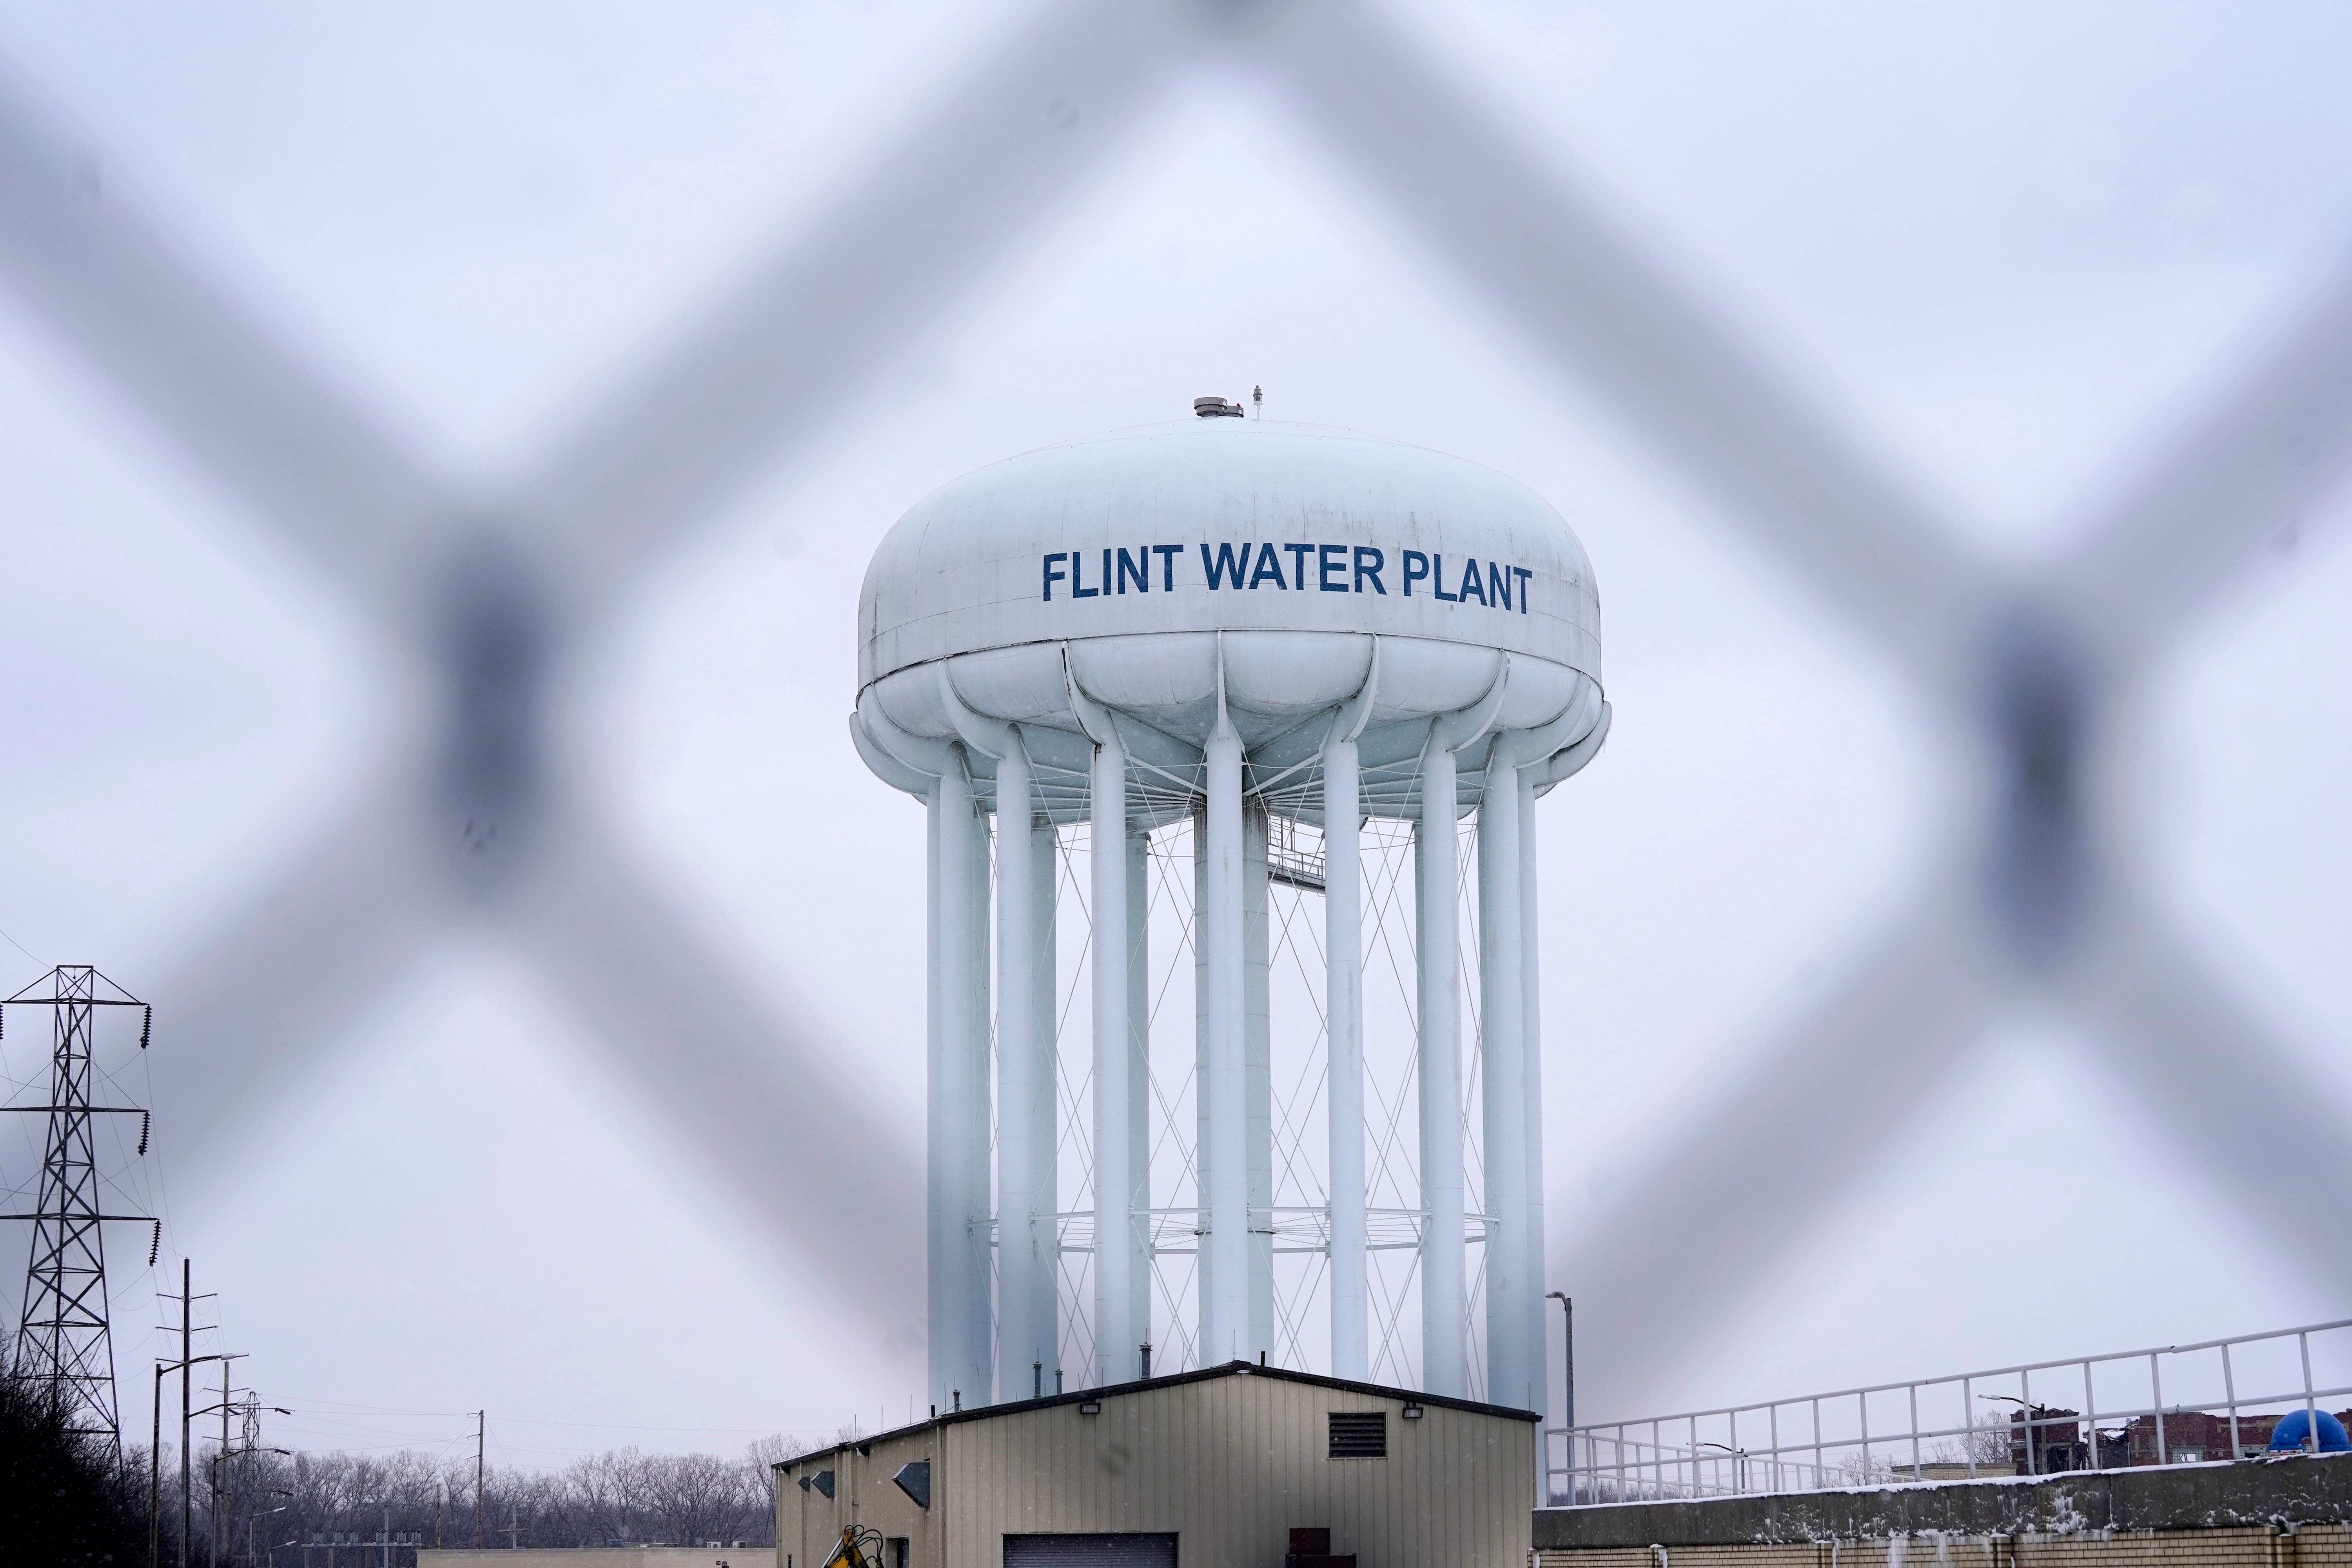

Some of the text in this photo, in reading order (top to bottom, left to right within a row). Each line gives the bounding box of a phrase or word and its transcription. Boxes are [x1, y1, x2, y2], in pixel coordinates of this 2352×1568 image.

[1043, 543, 1532, 614] FLINT WATER PLANT
